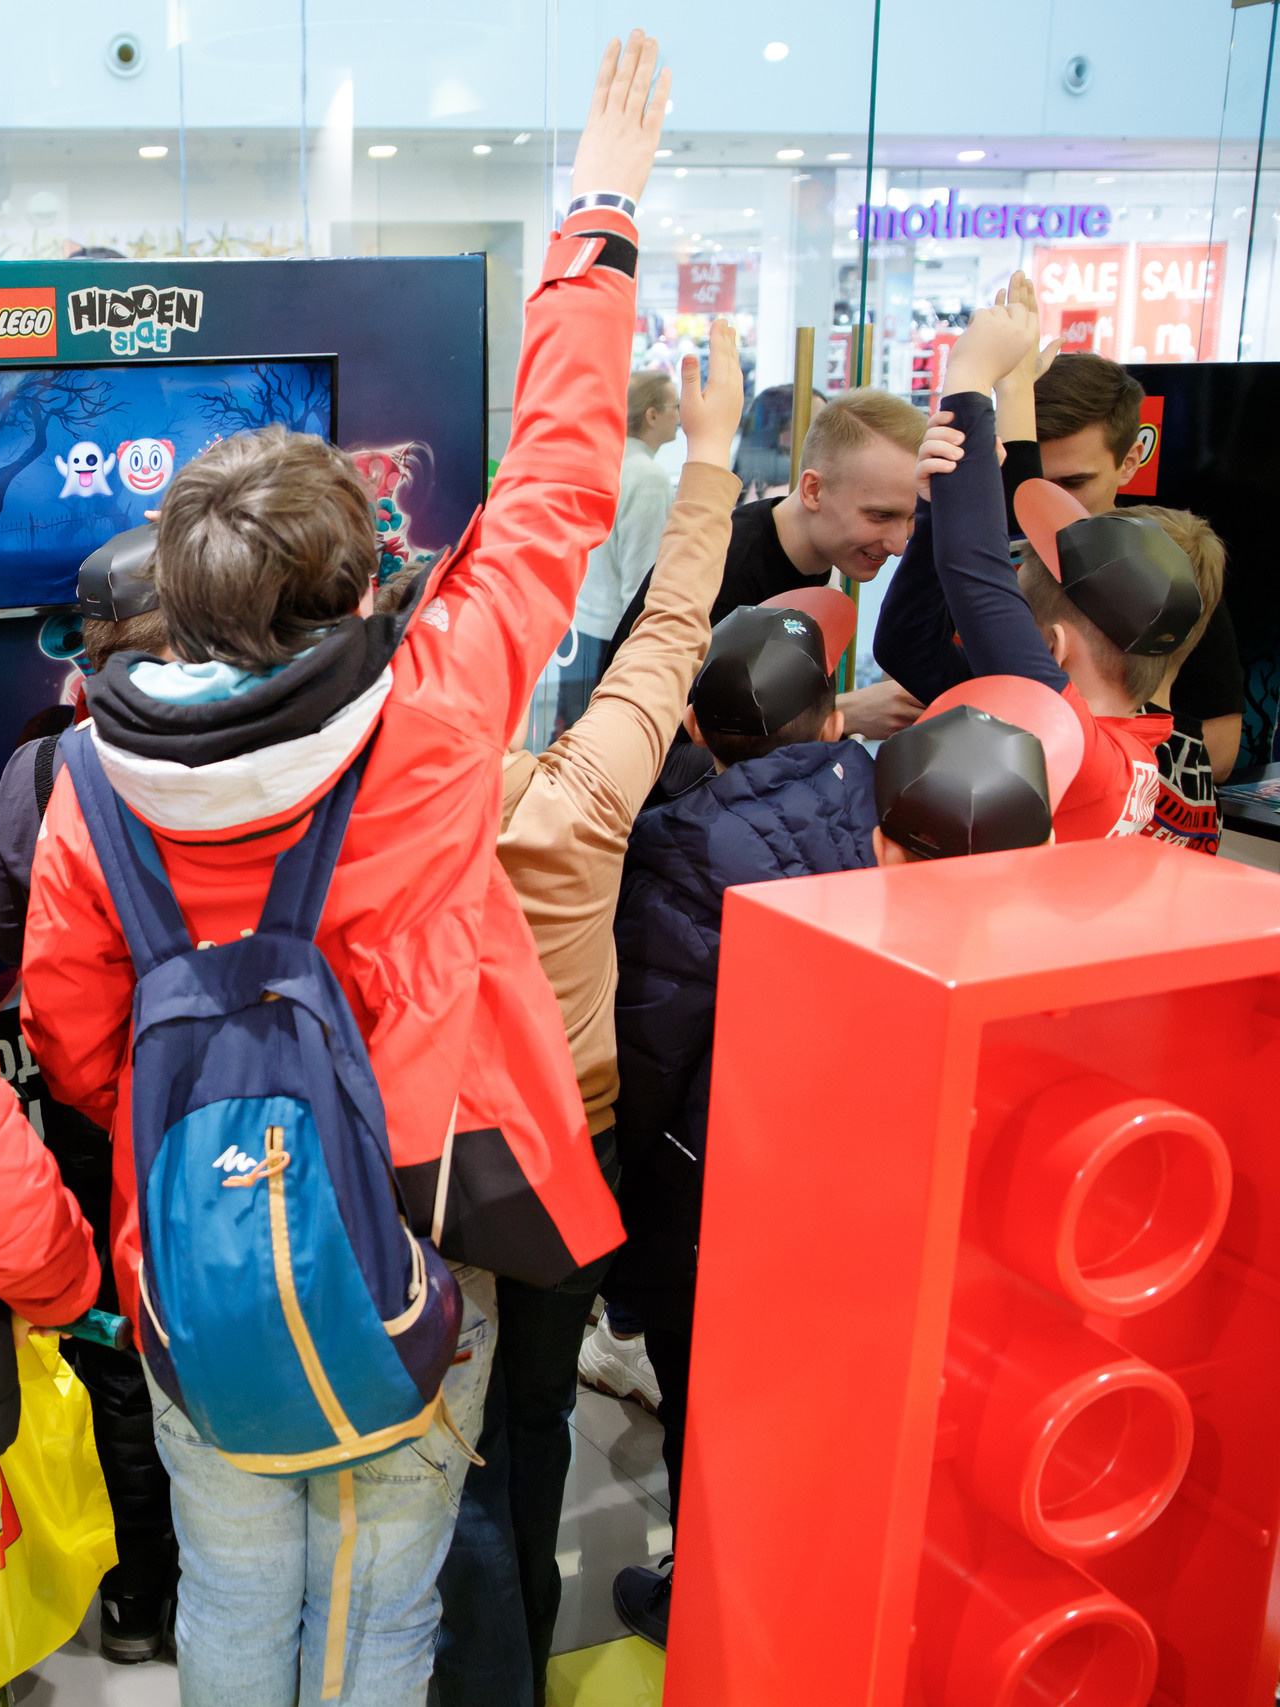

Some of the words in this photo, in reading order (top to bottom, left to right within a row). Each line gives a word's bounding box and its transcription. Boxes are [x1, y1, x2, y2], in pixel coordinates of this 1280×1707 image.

[857, 187, 1111, 239] mothercare
[1040, 262, 1118, 303] SALE
[1141, 260, 1216, 301] SALE
[71, 288, 198, 331] HIDDEN
[114, 321, 167, 352] SIDE
